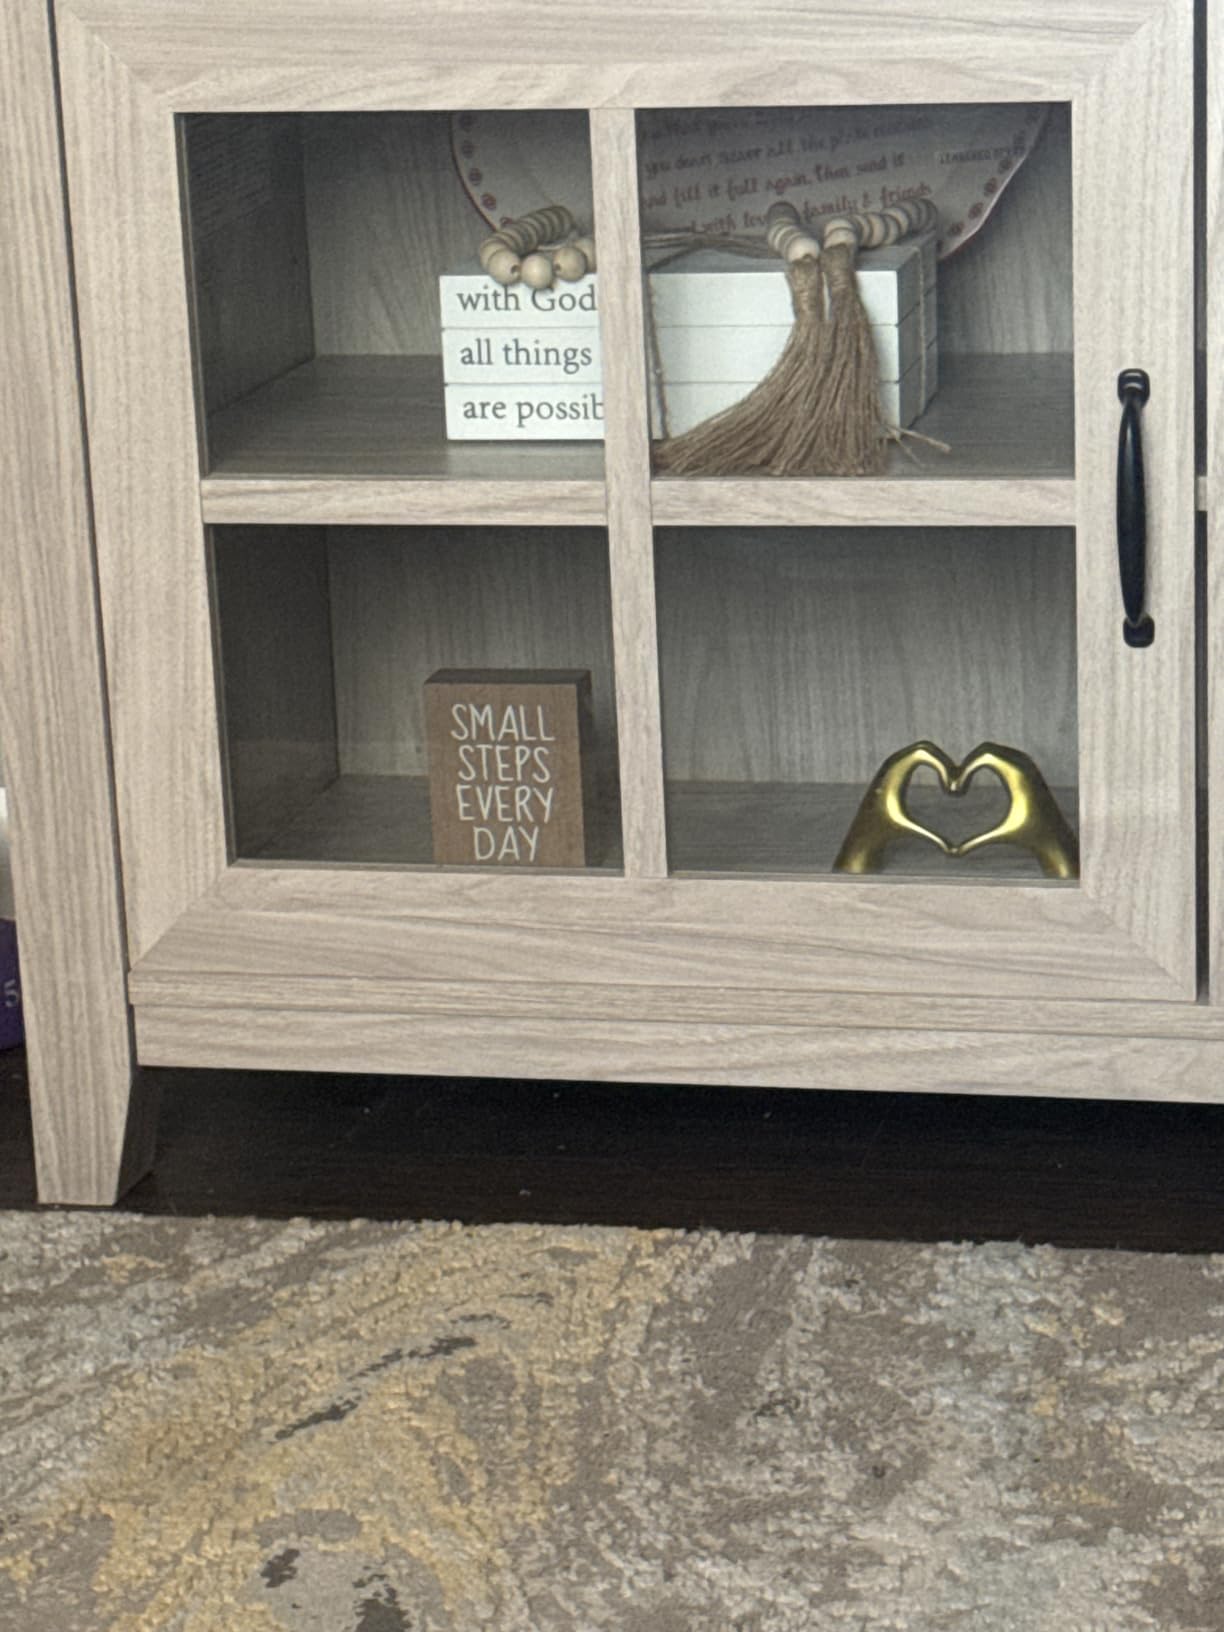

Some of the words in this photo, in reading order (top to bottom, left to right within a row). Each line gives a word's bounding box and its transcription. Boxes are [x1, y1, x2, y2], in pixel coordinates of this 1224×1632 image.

[744, 209, 770, 228] lov
[456, 284, 521, 311] with
[531, 284, 597, 312] God
[461, 337, 494, 365] all
[502, 338, 592, 375] things
[463, 400, 507, 419] are
[516, 393, 604, 428] possib
[450, 703, 555, 741] SMALL
[458, 744, 550, 783] STEPS
[456, 784, 553, 823] EVERY
[473, 826, 538, 862] DAY
